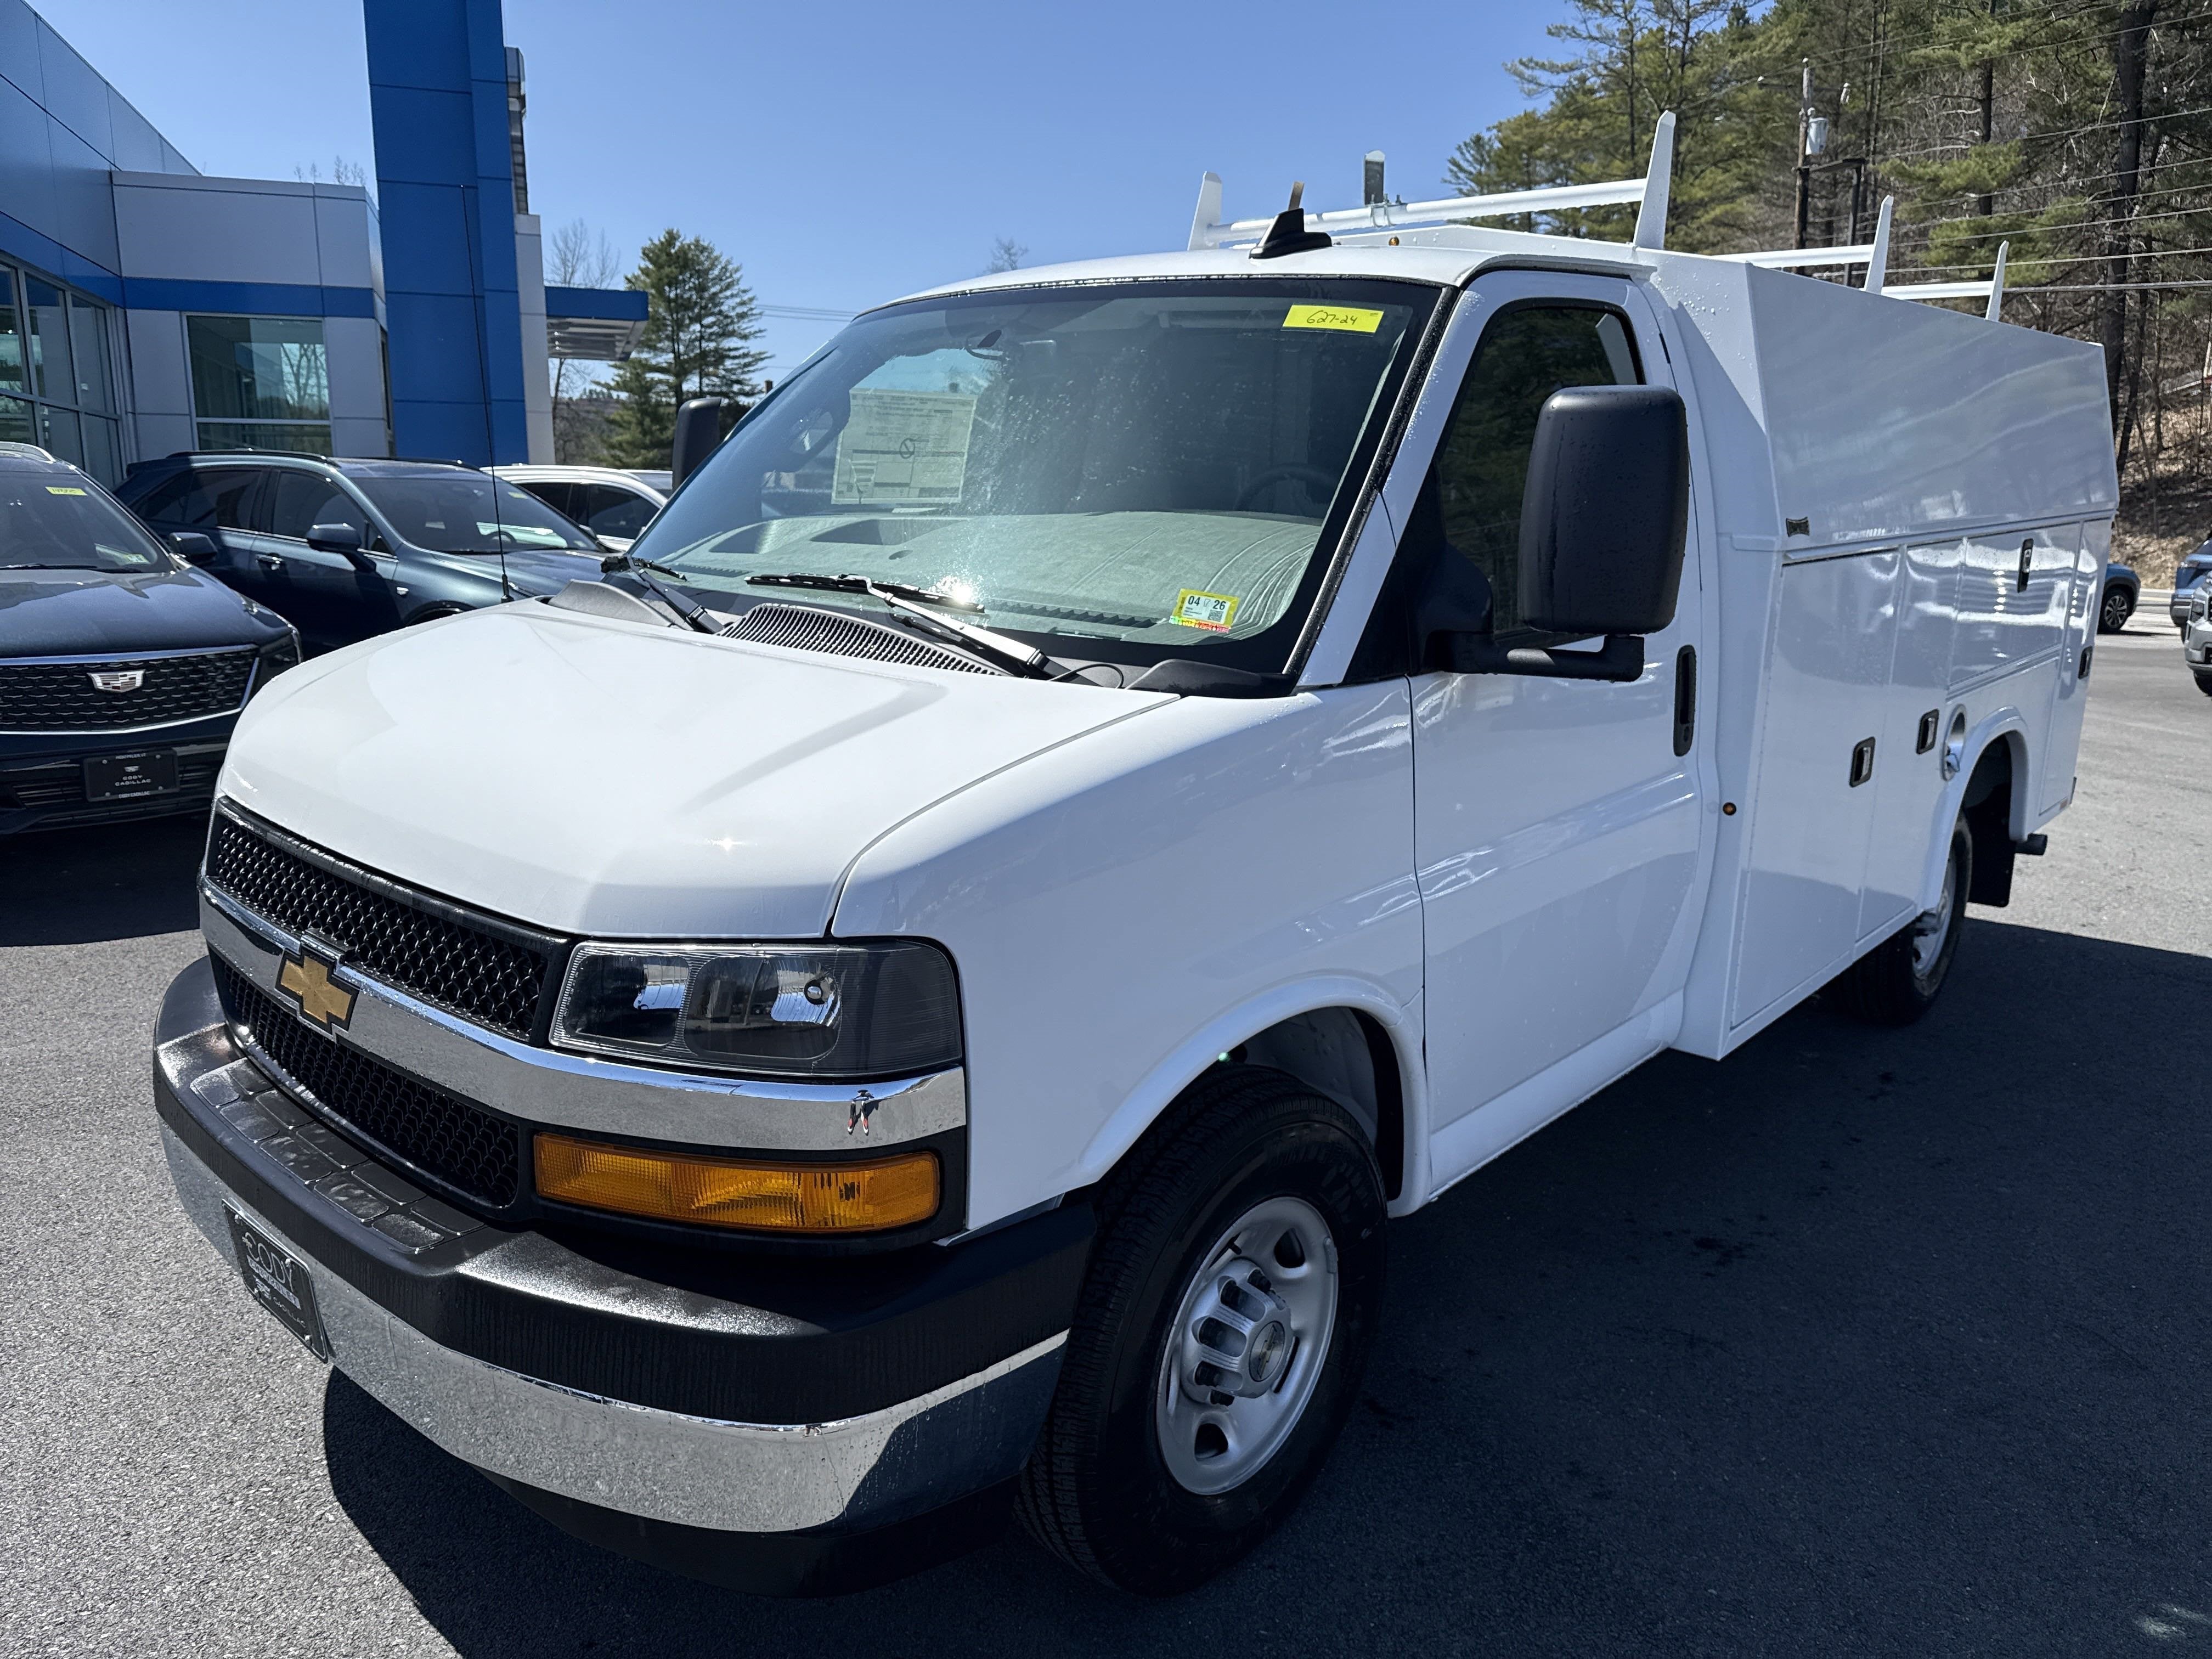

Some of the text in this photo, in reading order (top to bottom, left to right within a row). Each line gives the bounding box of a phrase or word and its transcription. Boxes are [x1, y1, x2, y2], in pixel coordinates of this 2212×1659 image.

[1306, 309, 1358, 325] 627-24
[1187, 595, 1201, 606] 04
[1212, 600, 1227, 611] 26
[245, 1232, 294, 1293] CODY
